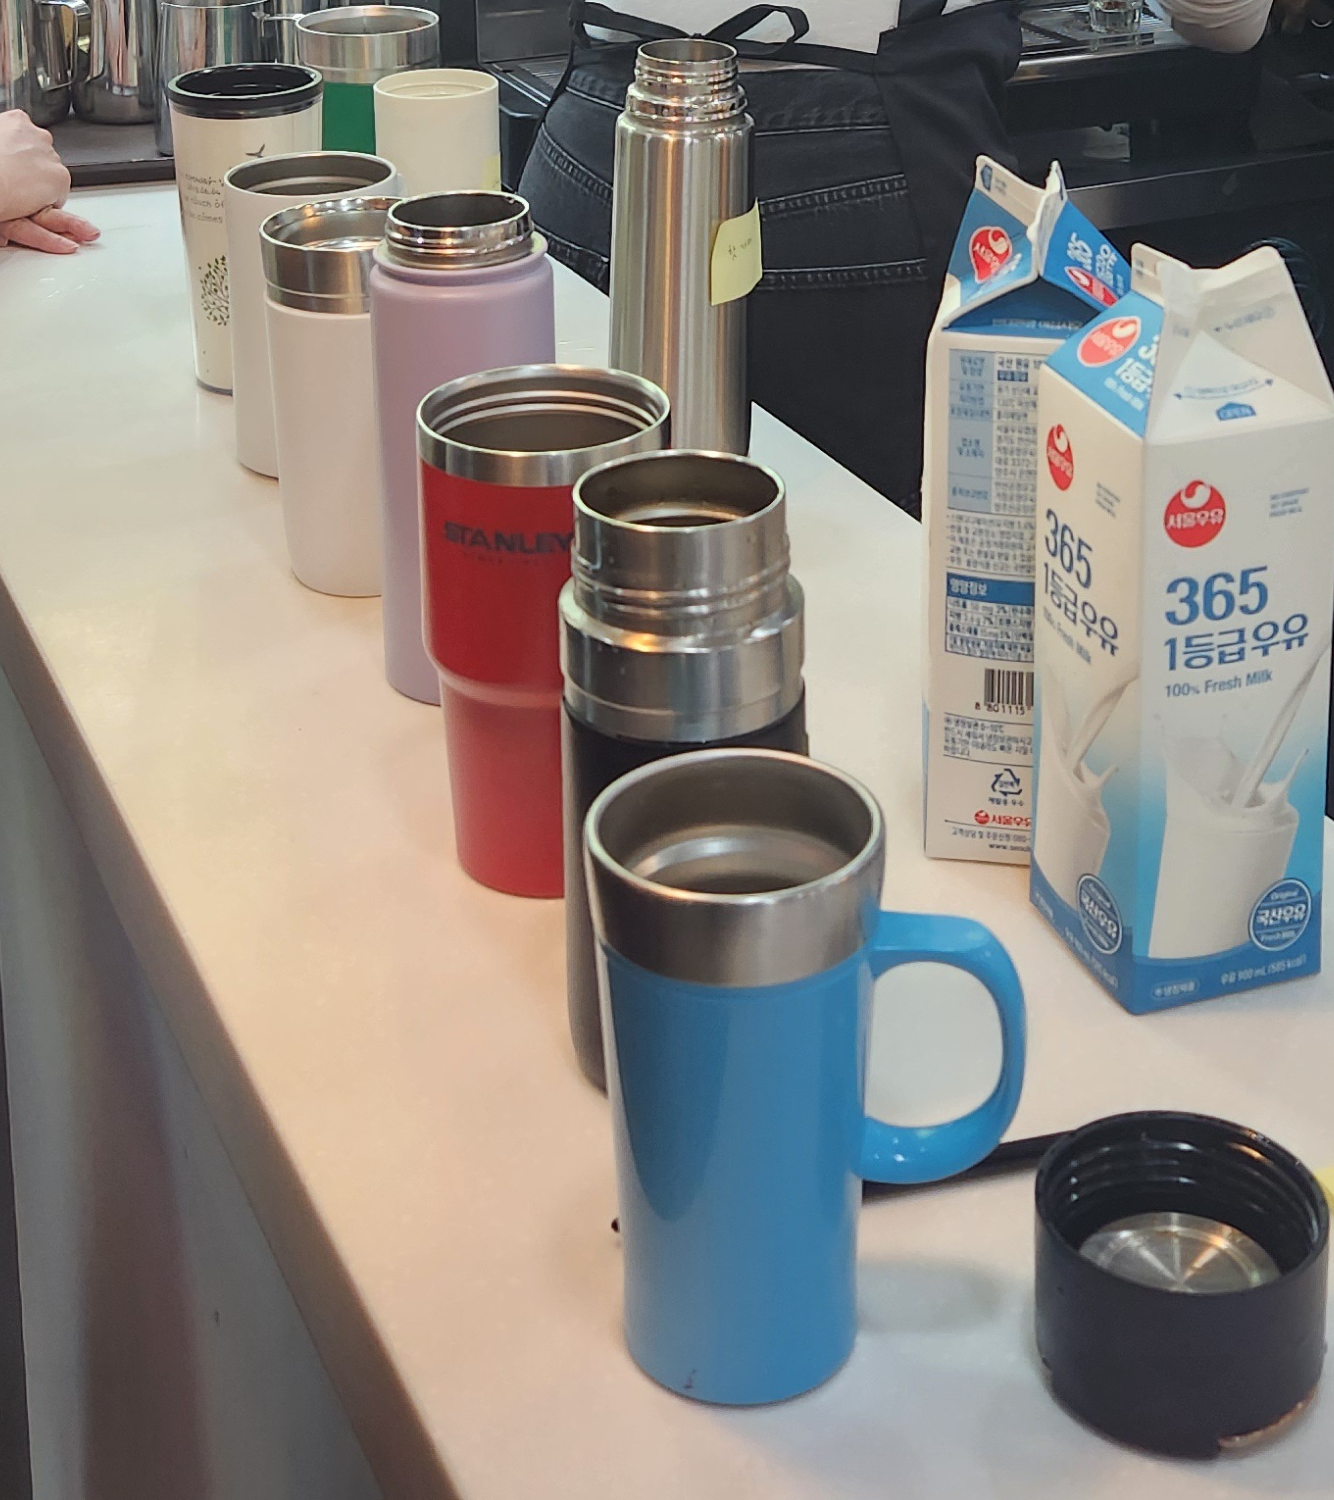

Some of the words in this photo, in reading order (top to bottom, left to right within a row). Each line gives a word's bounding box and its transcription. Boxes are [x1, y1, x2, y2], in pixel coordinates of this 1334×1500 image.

[444, 520, 574, 554] STANLEY
[1166, 508, 1224, 530] 서울우유
[1044, 507, 1093, 590] 365
[1043, 561, 1119, 657] 1등급우유
[1164, 564, 1269, 626] 365
[1164, 613, 1309, 672] 1등급우유
[1164, 682, 1200, 698] 100%
[1204, 675, 1242, 694] Fresh
[1245, 668, 1273, 687] Milk
[1256, 903, 1307, 927] 국산우유
